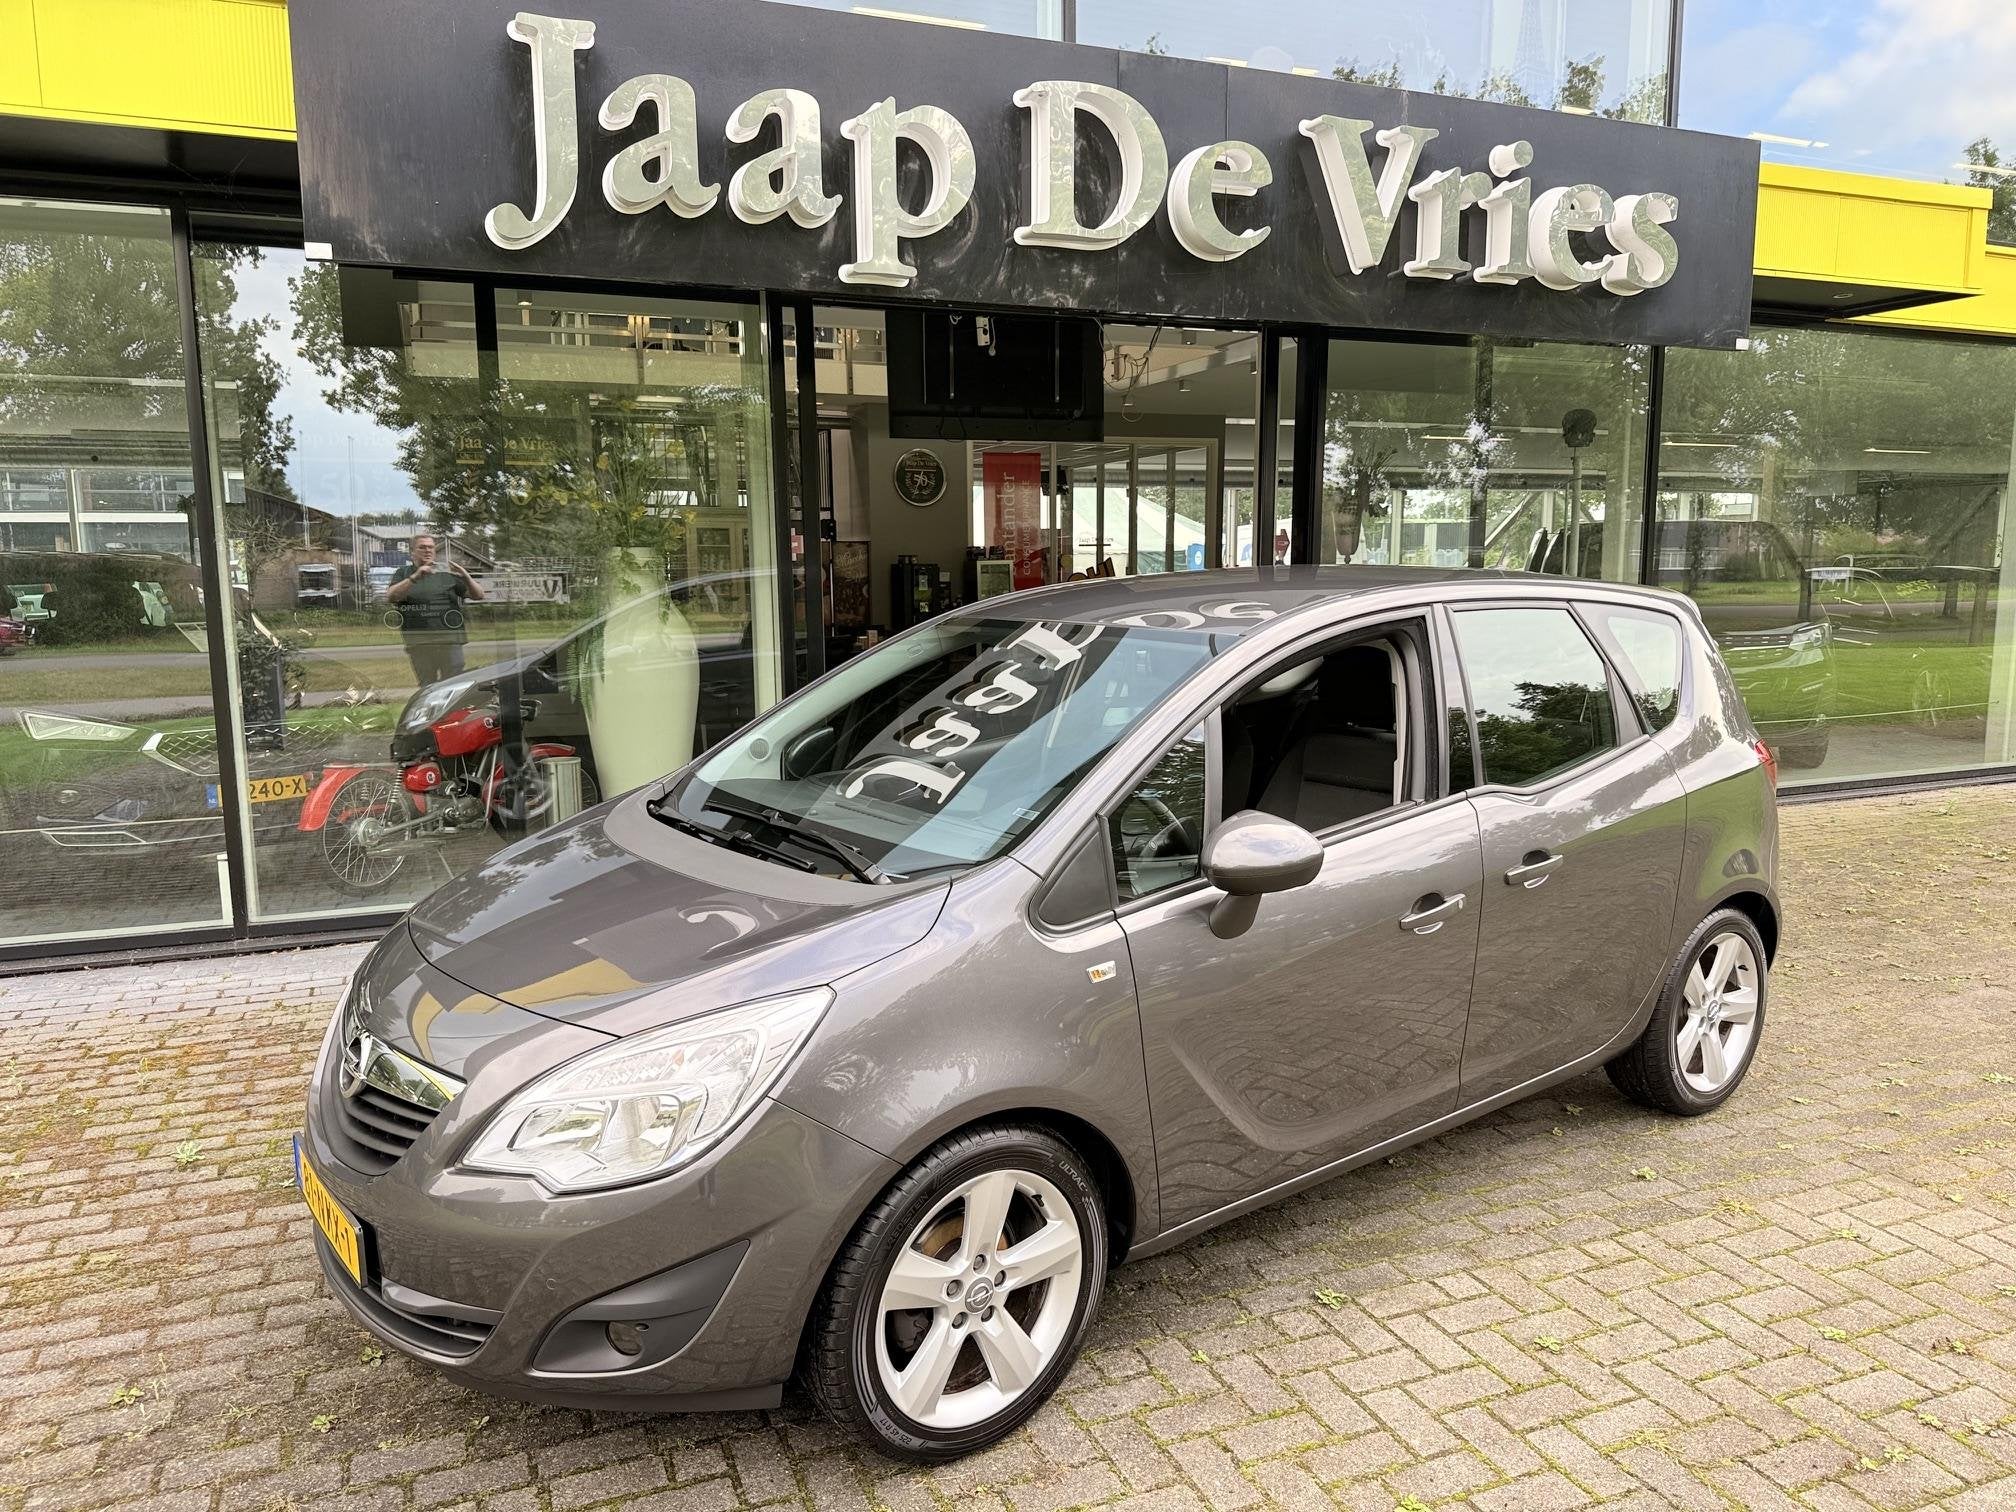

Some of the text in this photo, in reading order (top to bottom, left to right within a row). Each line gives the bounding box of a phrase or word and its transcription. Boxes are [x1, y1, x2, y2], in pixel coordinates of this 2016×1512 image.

[485, 12, 1679, 296] Jaap De Vries
[458, 435, 483, 451] Jaa
[997, 472, 1016, 576] antander
[1022, 520, 1032, 576] CONSUMER
[249, 777, 308, 799] 240-X
[1058, 1160, 1088, 1192] ULTRAC
